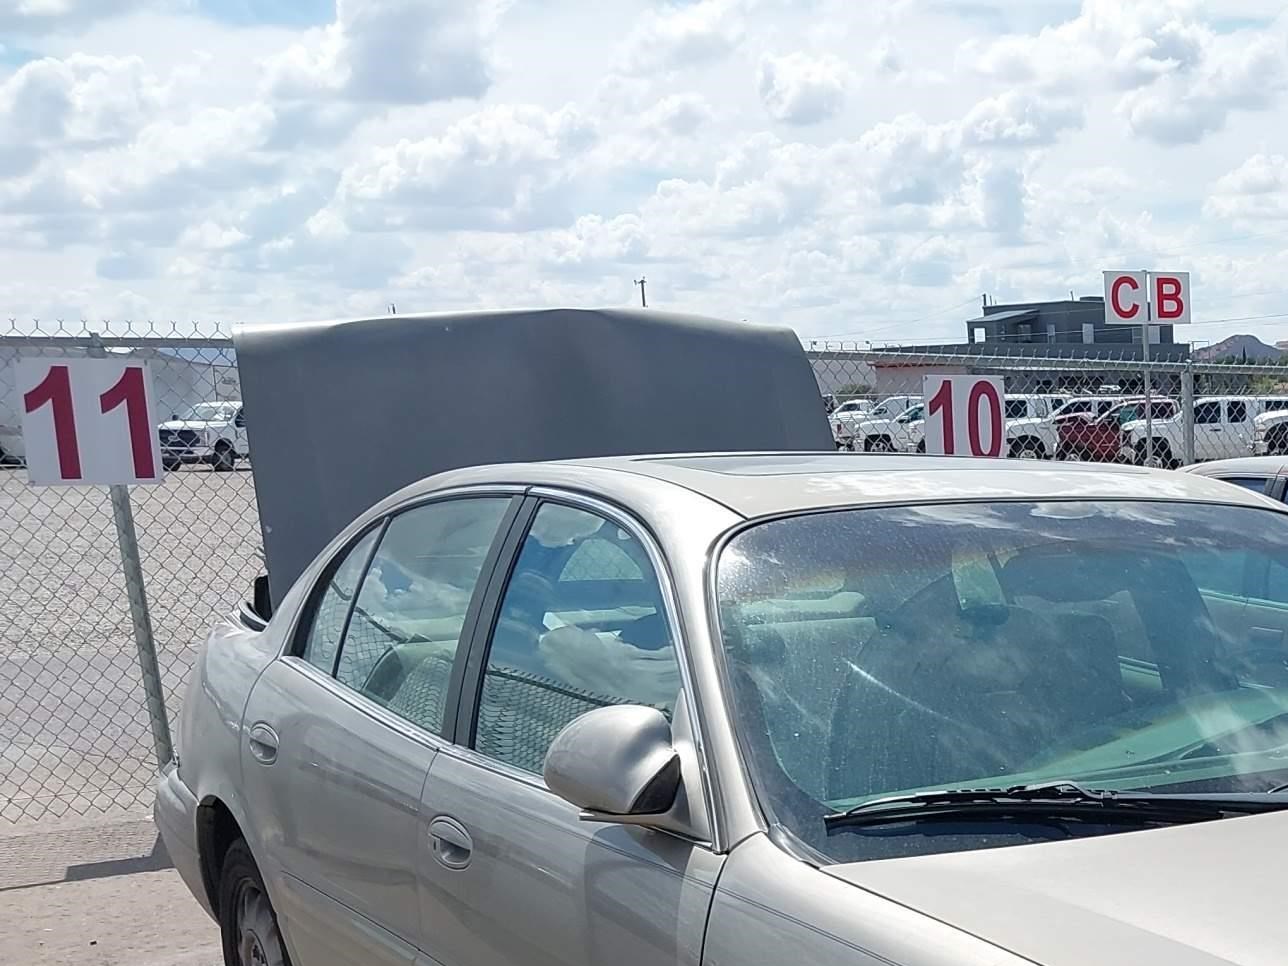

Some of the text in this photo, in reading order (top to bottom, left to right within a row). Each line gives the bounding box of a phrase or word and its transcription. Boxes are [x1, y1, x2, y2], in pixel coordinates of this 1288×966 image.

[1112, 276, 1139, 318] C
[1157, 277, 1184, 318] B
[24, 366, 155, 479] 11
[929, 380, 1002, 456] 10
